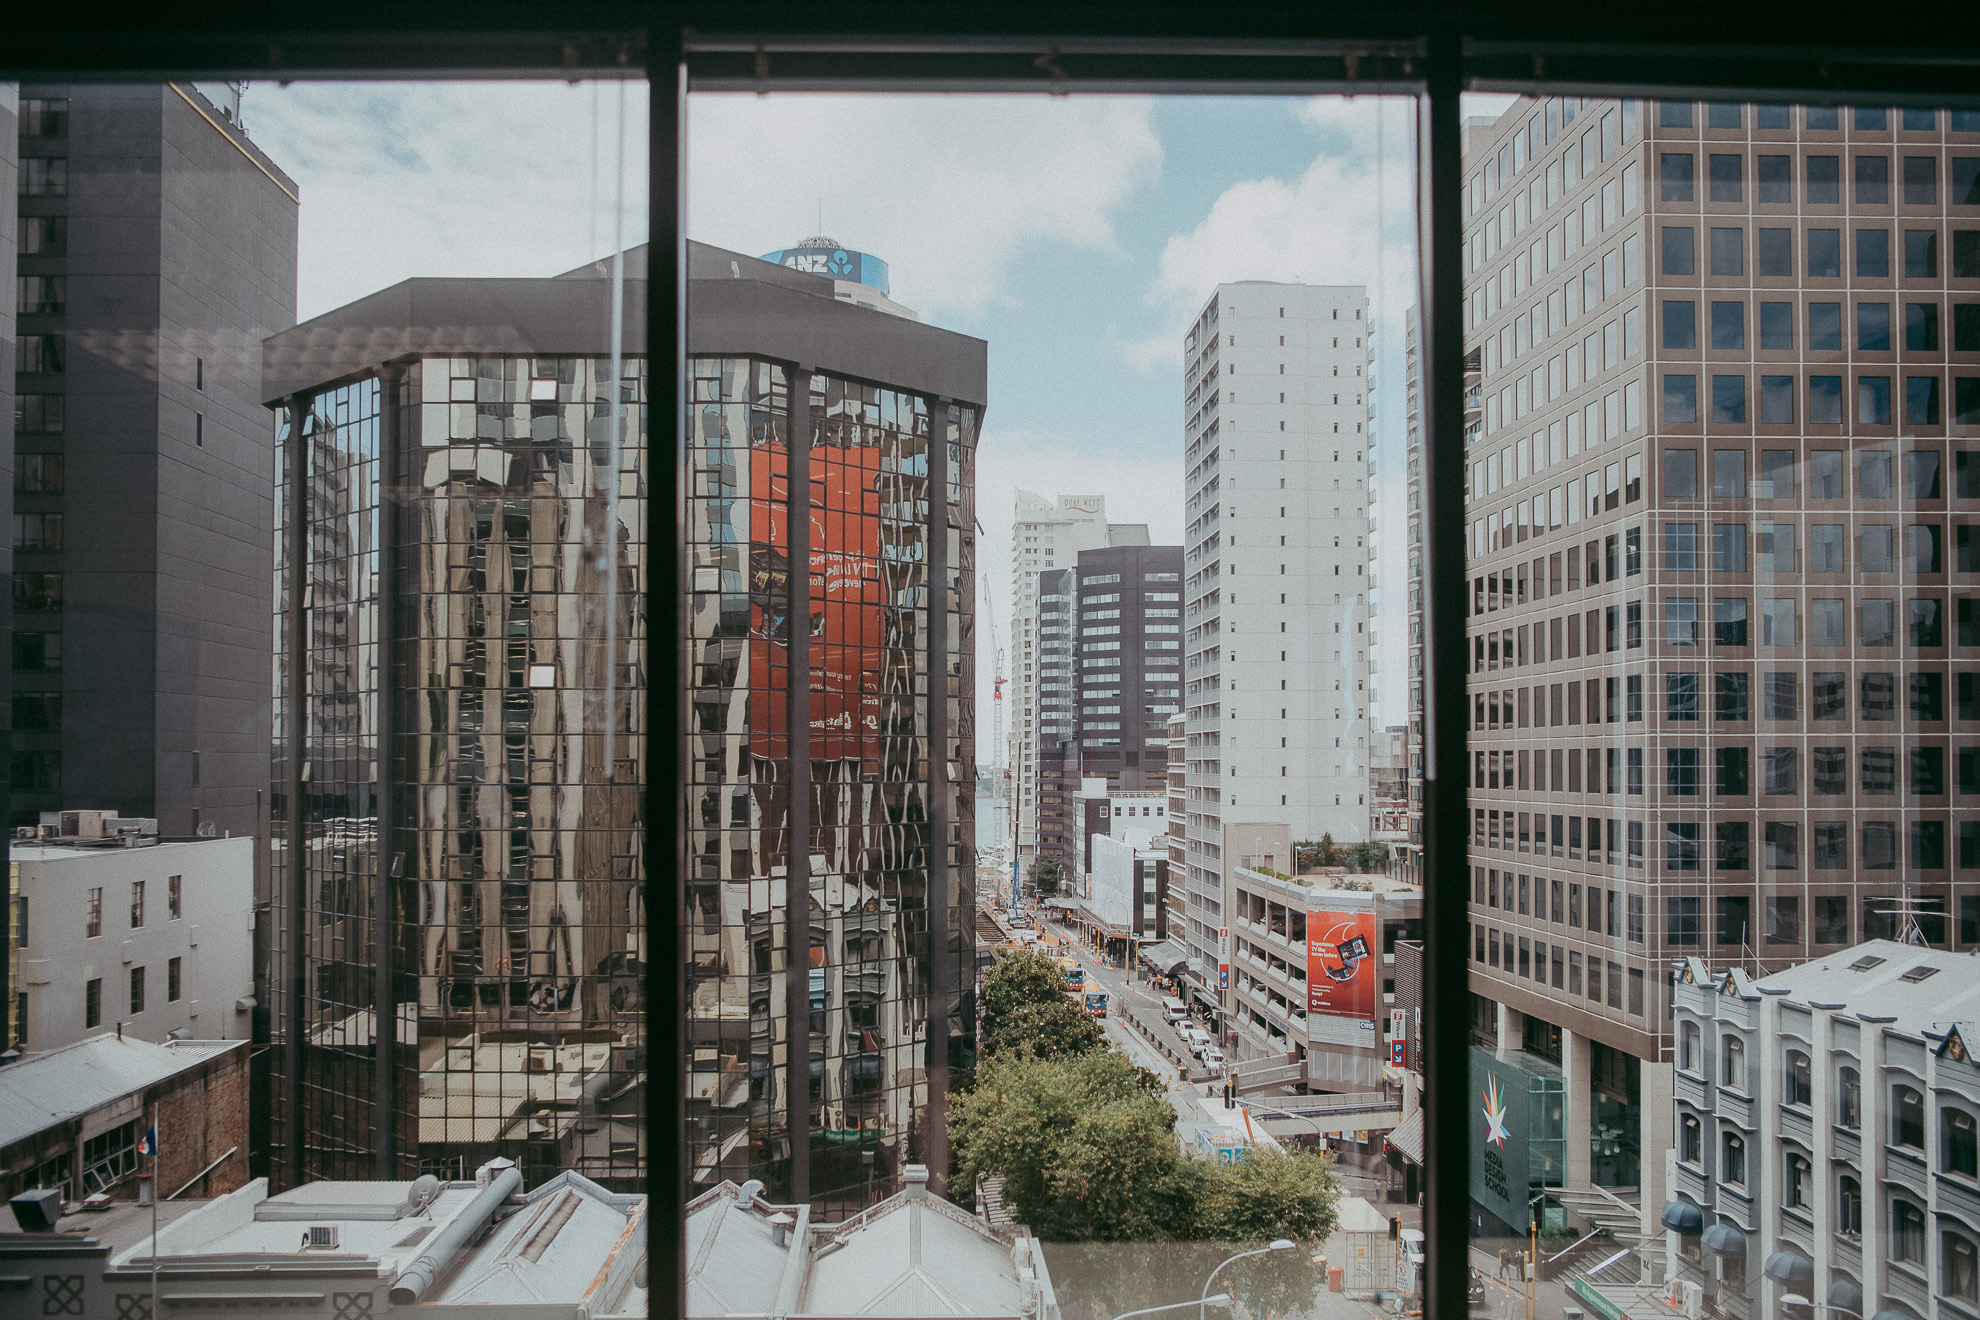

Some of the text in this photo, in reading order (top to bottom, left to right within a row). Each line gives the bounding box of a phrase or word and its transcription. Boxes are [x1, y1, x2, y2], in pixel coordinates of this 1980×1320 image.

[784, 254, 828, 273] ANZ
[1064, 498, 1101, 507] QUAY WEST
[1395, 1044, 1402, 1052] P
[1484, 1148, 1503, 1171] MEDIA
[1484, 1160, 1507, 1186] DESIGN
[1484, 1174, 1510, 1203] SCHOOL
